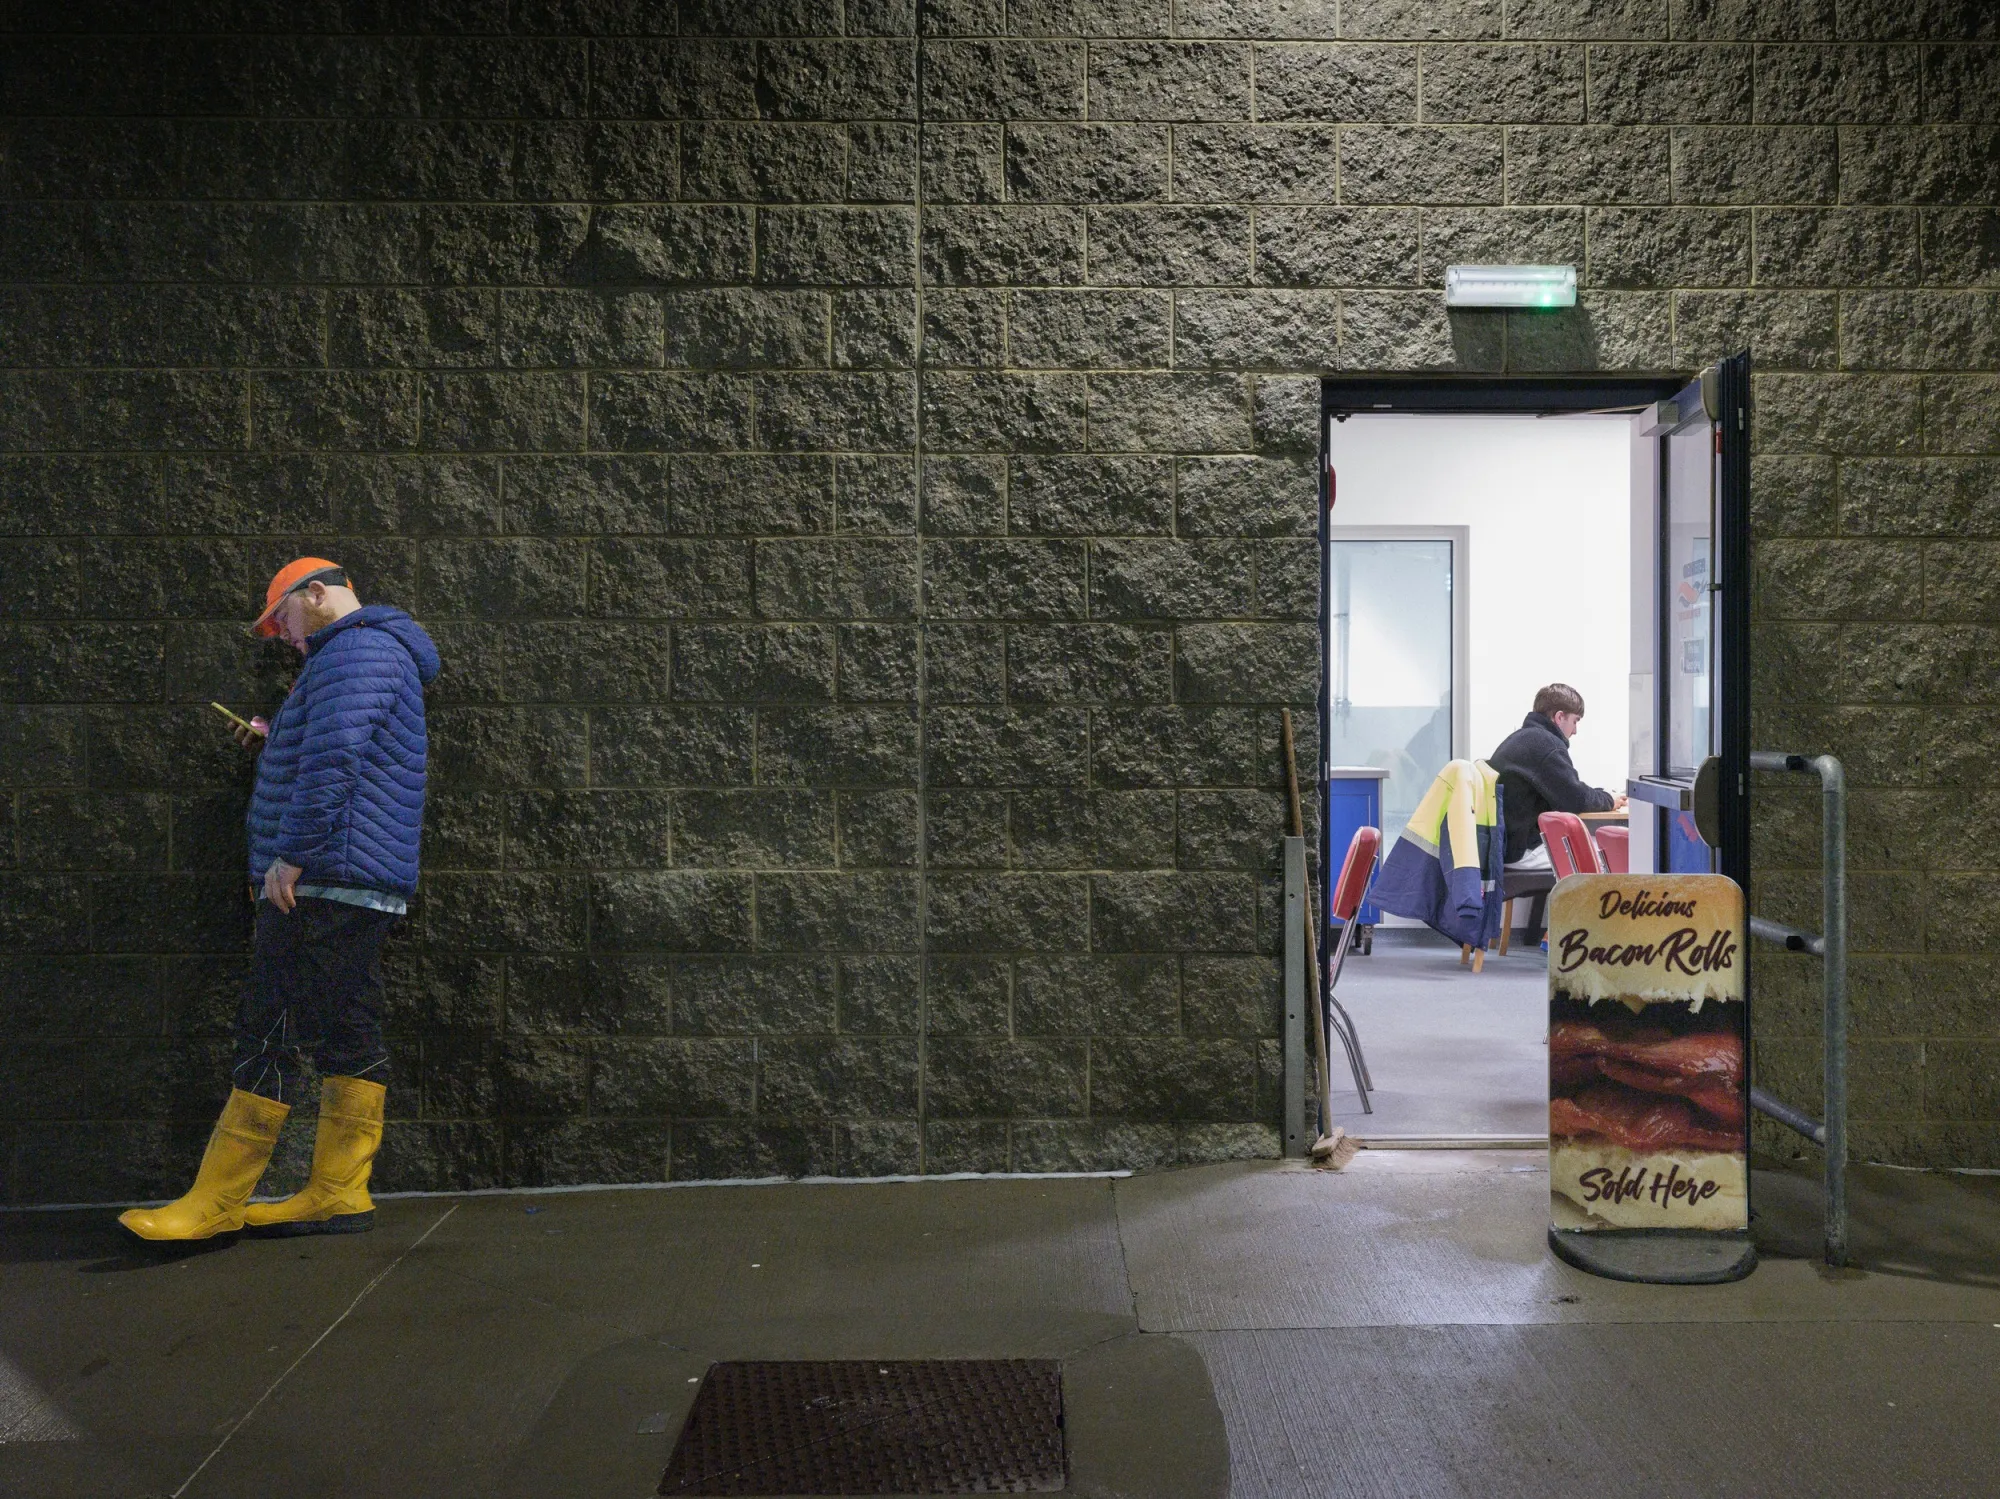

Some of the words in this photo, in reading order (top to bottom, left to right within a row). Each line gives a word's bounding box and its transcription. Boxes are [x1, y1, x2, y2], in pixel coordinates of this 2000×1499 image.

[1599, 890, 1697, 920] Delicious
[1558, 928, 1662, 972] Bacon
[1660, 928, 1737, 976] Rolls
[1579, 1166, 1648, 1204] Sold
[1649, 1164, 1721, 1209] Here
